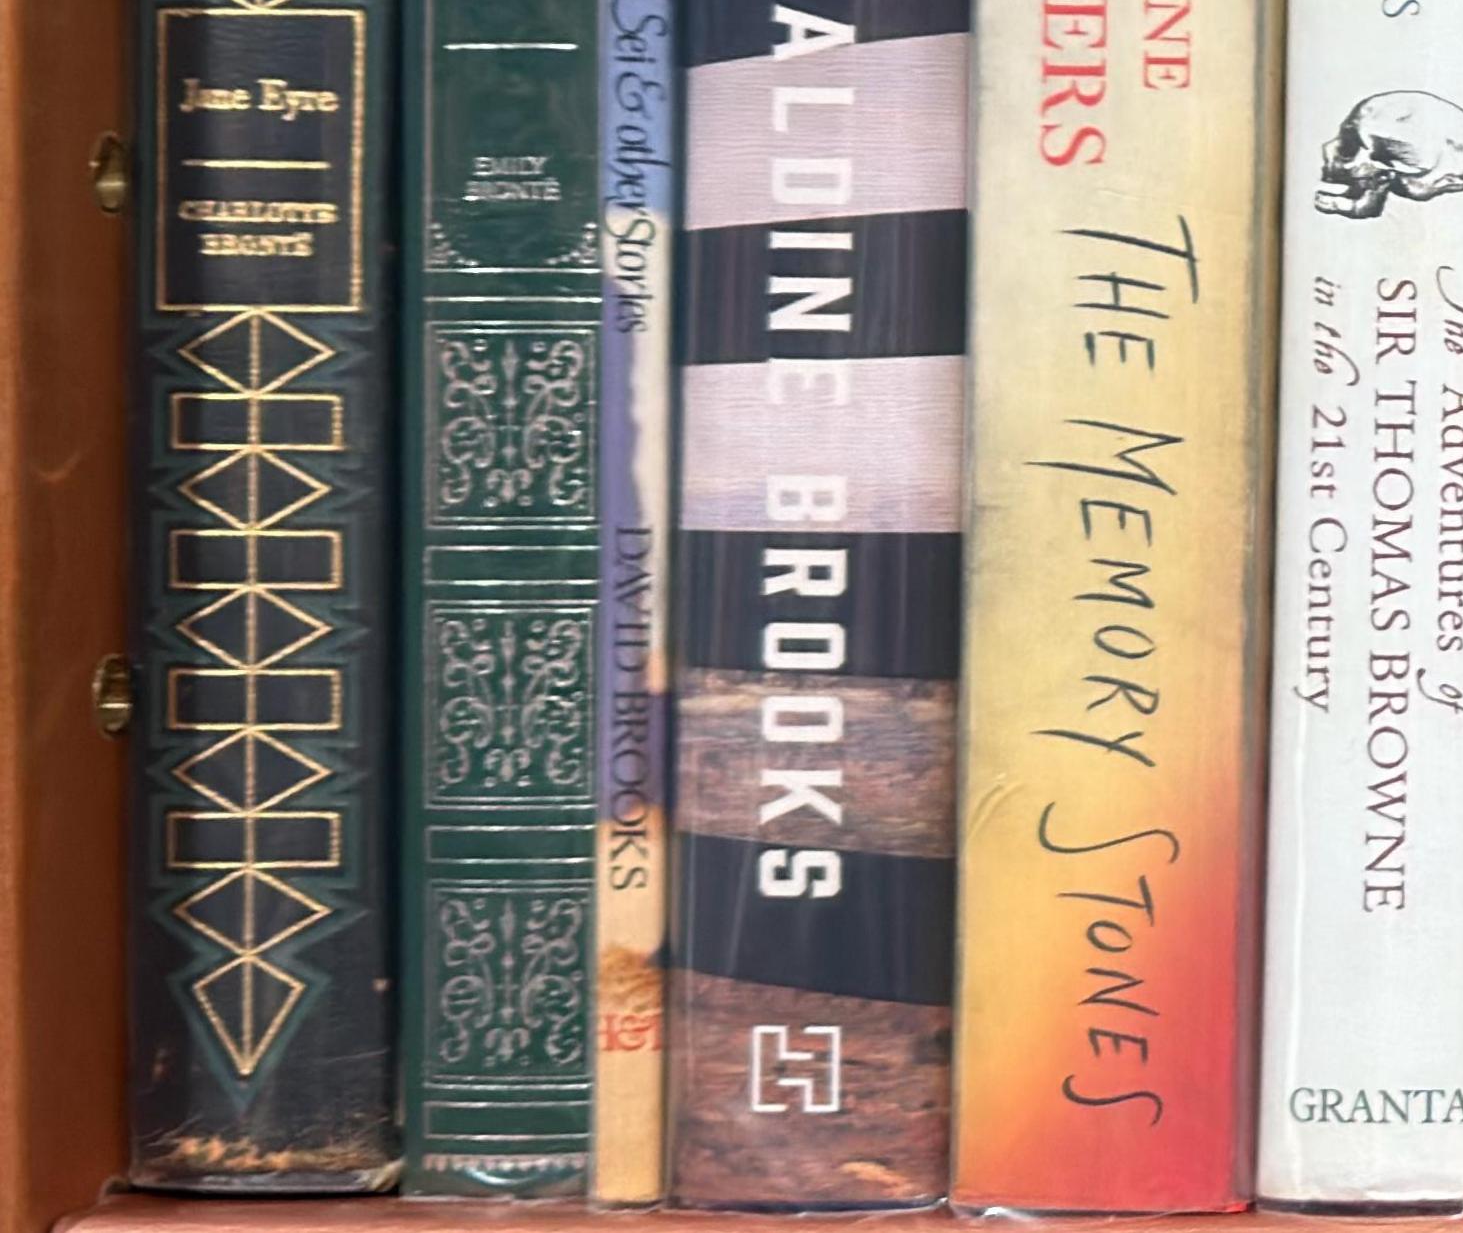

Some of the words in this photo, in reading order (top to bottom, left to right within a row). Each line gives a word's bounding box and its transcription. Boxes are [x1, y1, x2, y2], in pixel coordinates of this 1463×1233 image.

[179, 78, 251, 112] Jane
[256, 78, 340, 121] Eyre
[472, 155, 549, 176] EMILY
[609, 124, 672, 211] other
[178, 199, 340, 224] CHARLOTTE
[604, 195, 657, 334] Stories
[1056, 213, 1202, 380] THE
[1313, 275, 1342, 308] in
[1313, 321, 1361, 386] the
[1375, 276, 1418, 365] SIR
[1308, 403, 1348, 499] 21st
[1369, 379, 1418, 632] THOMAS
[612, 527, 653, 676] DAVID
[1024, 415, 1187, 770] MEMORY
[1293, 517, 1349, 714] Century
[756, 474, 849, 900] BROOKS
[610, 692, 650, 892] BROOKS
[1362, 650, 1411, 914] BROWNE
[1036, 799, 1182, 1128] STONES
